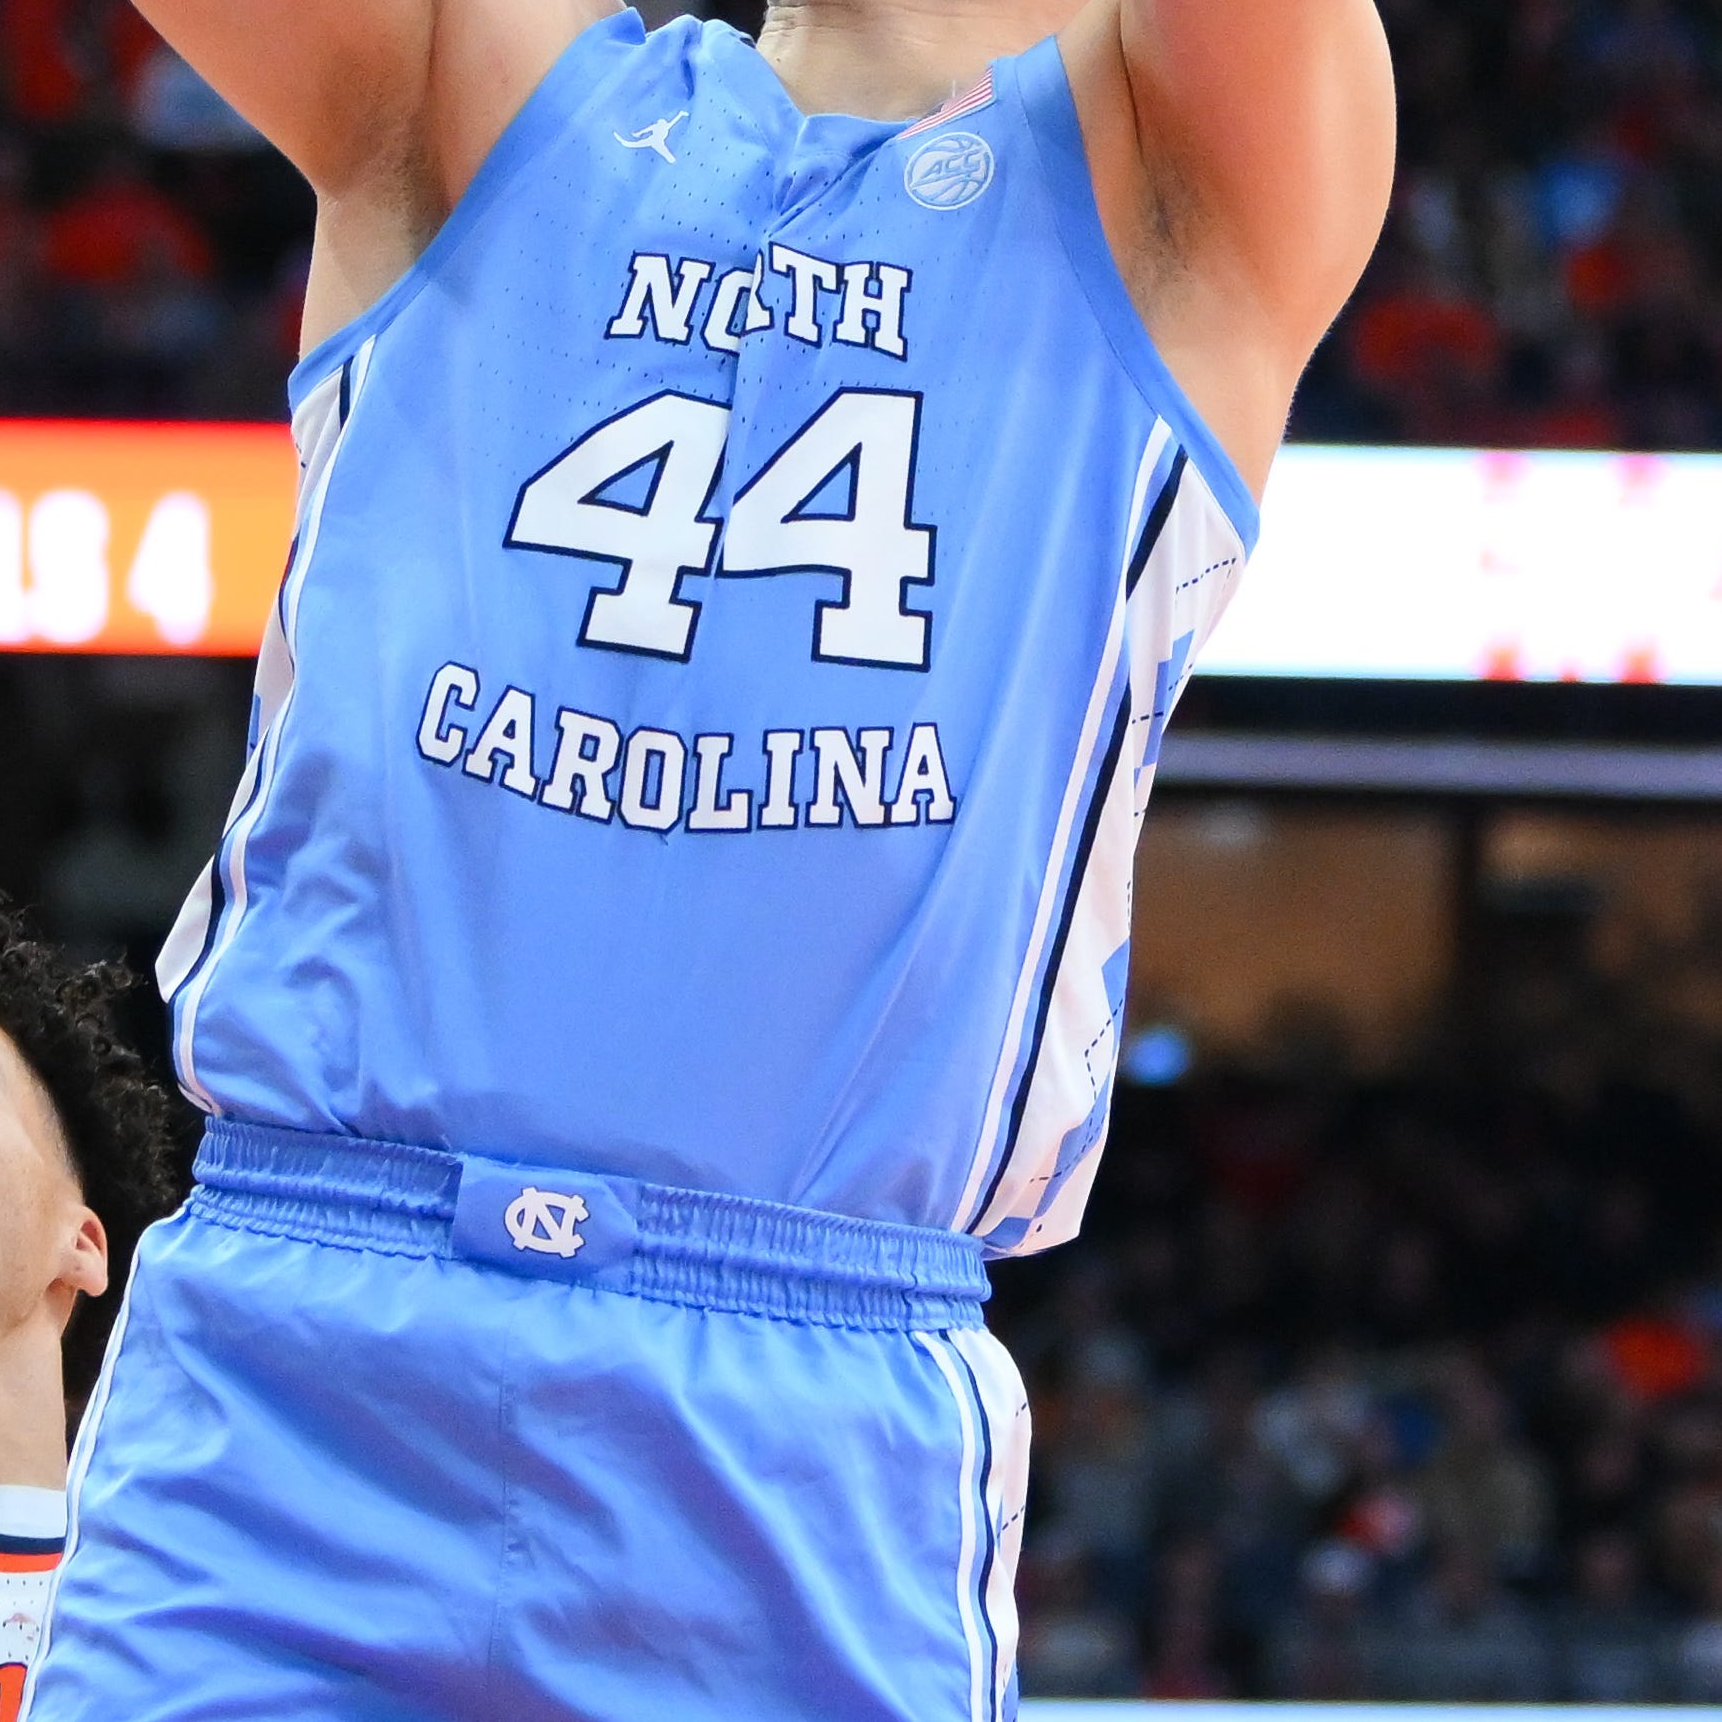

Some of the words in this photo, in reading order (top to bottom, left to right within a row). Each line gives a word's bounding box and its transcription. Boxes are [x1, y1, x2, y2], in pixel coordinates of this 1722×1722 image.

[124, 490, 213, 646] 4
[502, 385, 938, 673] 44
[416, 660, 957, 834] CAROLINA
